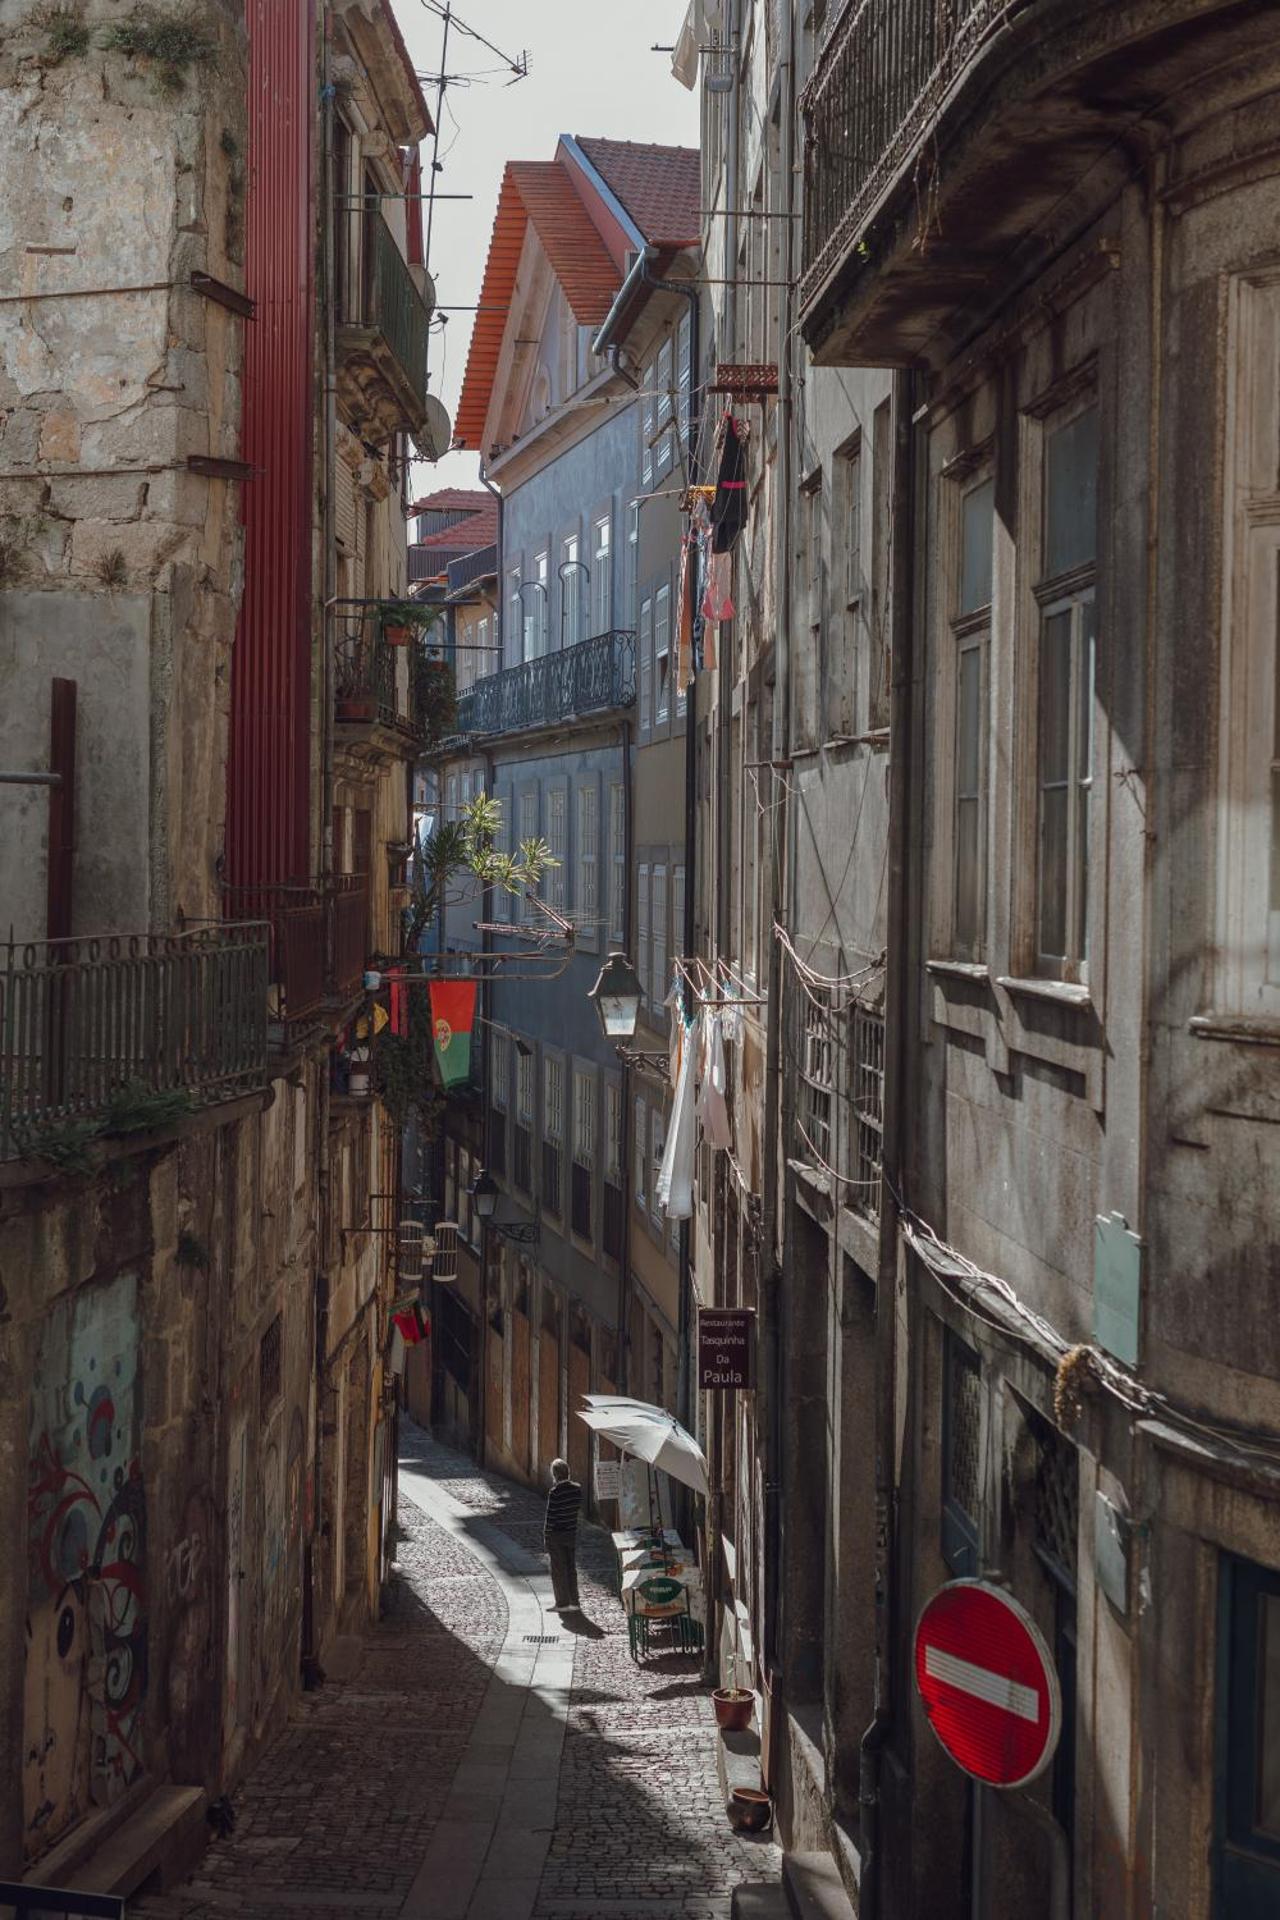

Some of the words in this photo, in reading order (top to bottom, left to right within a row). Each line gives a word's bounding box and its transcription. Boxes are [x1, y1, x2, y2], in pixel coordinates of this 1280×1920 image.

[700, 1319, 745, 1327] Restaurante
[701, 1334, 745, 1346] Tasquinha
[716, 1354, 730, 1364] Da
[704, 1370, 742, 1383] Paula
